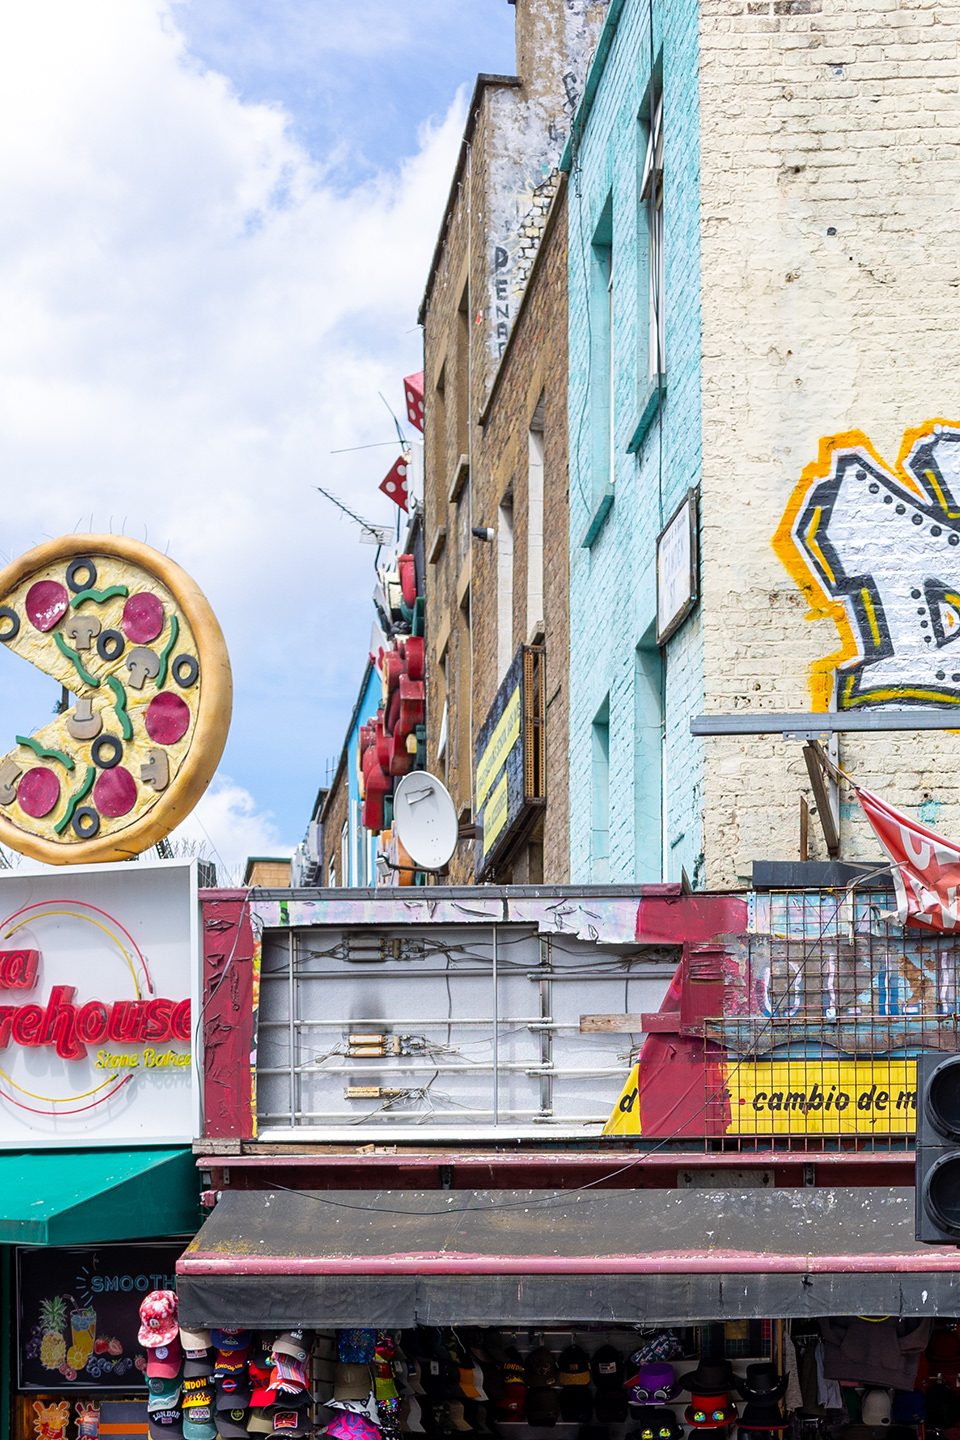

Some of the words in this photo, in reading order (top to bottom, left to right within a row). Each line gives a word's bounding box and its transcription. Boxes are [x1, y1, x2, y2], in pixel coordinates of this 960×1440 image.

[95, 1050, 139, 1068] Stone
[752, 1083, 854, 1112] cambio
[857, 1083, 888, 1111] de
[91, 1274, 177, 1292] SMOOTH
[184, 1377, 206, 1390] NDON
[152, 1410, 181, 1421] LONDON
